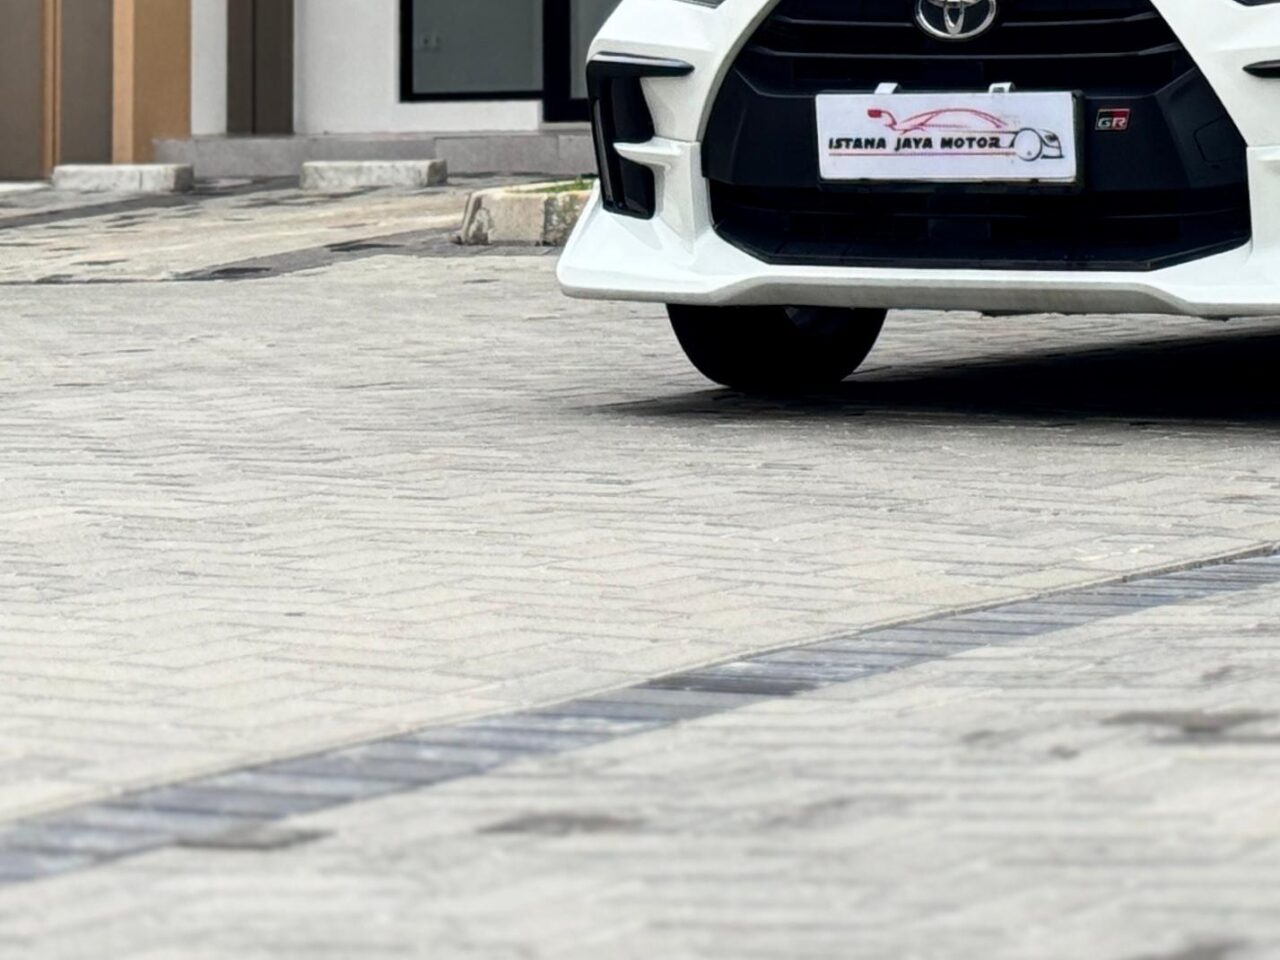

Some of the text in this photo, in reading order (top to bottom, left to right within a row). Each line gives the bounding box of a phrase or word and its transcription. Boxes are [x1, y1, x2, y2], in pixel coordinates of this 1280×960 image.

[1097, 114, 1126, 129] GR
[828, 136, 1000, 152] ISTANA JAYA MOTOR
